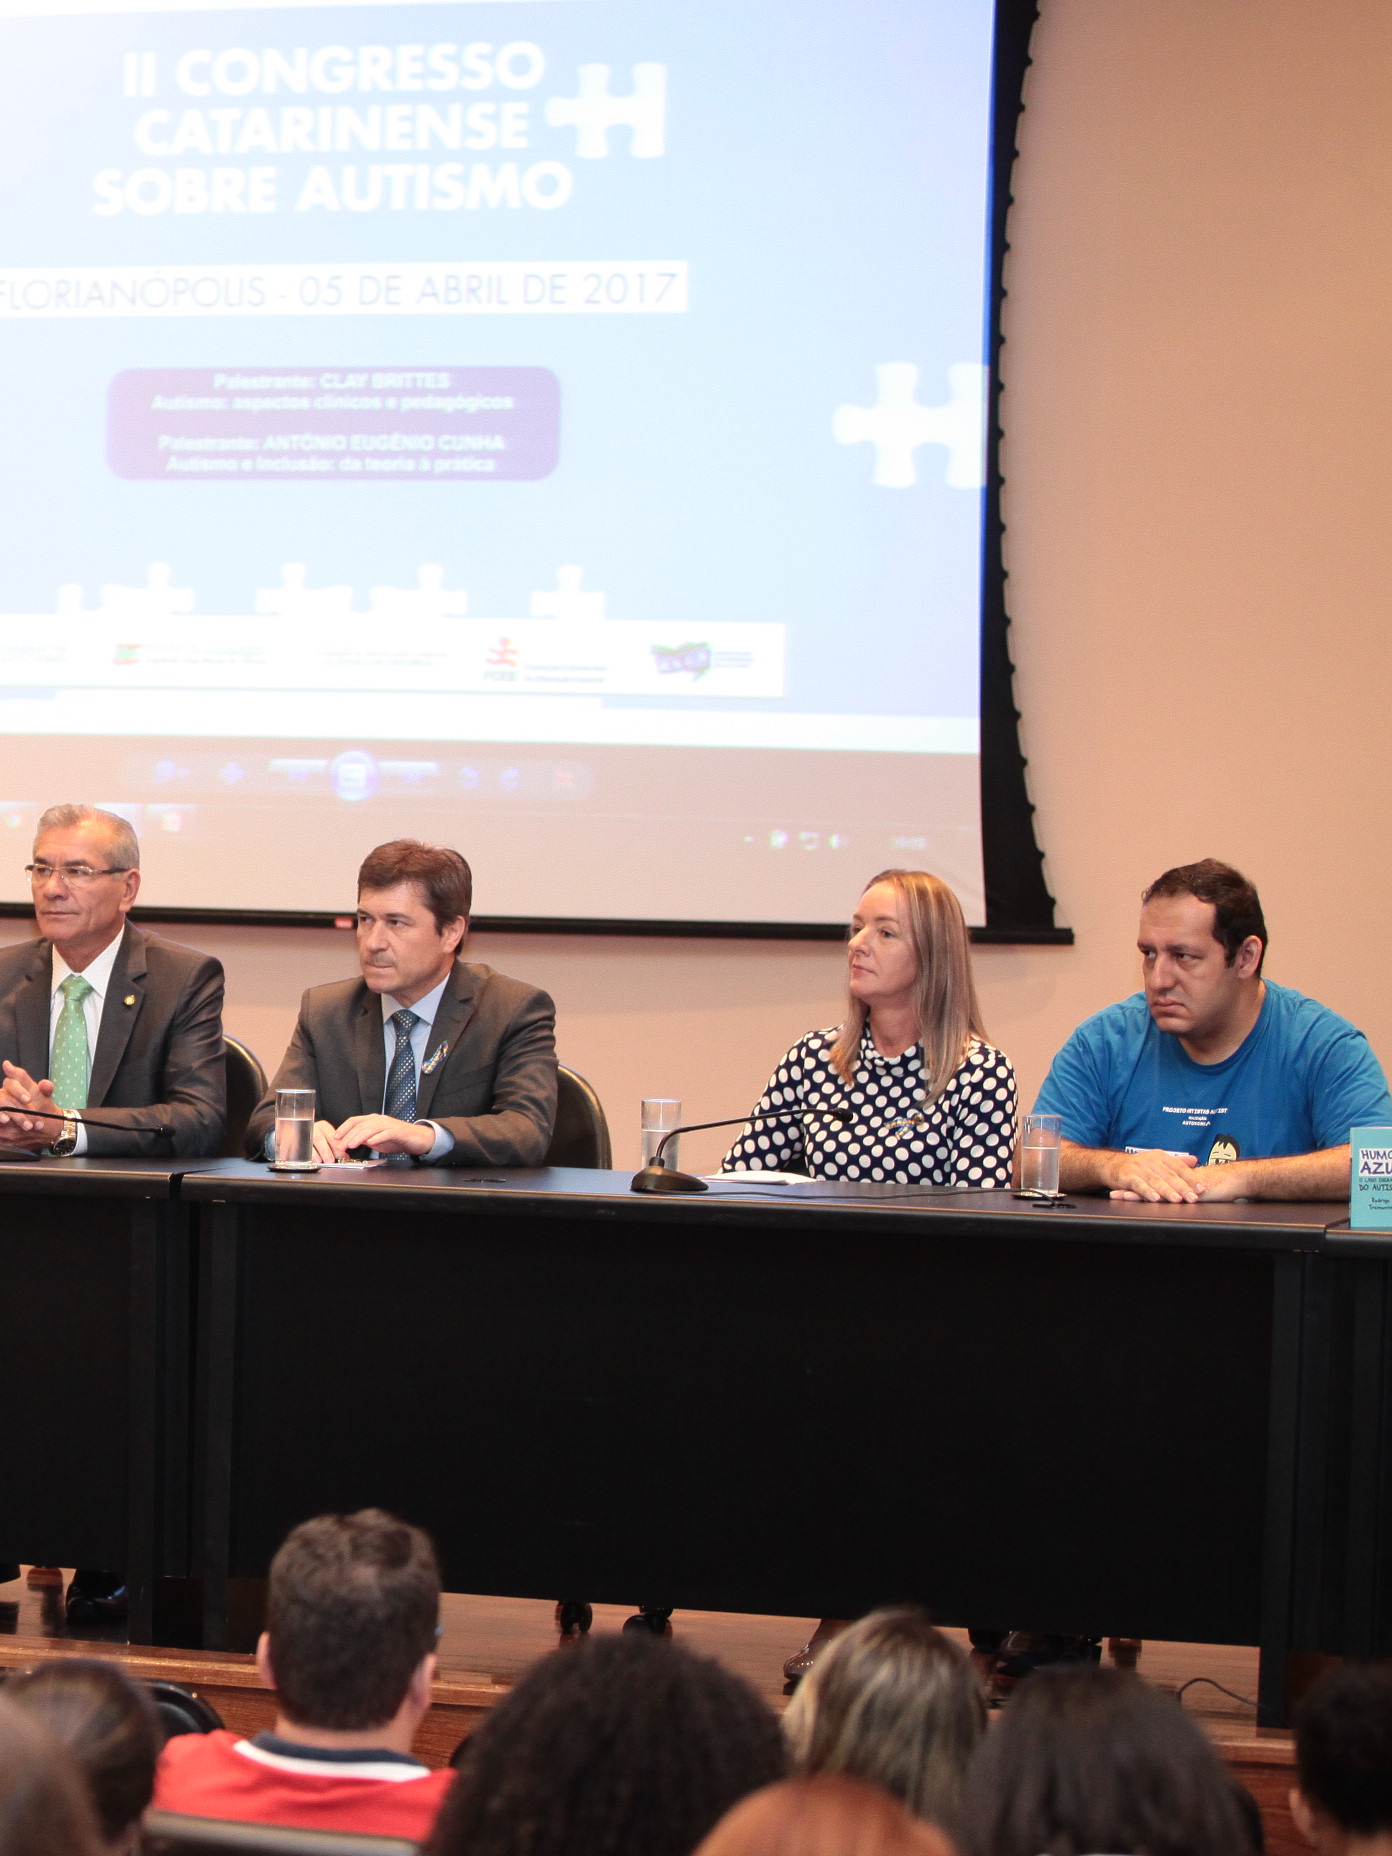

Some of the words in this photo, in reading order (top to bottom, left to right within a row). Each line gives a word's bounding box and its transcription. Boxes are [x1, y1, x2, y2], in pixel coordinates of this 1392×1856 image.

[175, 41, 546, 97] CONGRESSO
[134, 102, 529, 157] CATARINENSE
[92, 165, 277, 217] SOBRE
[295, 161, 574, 213] AUTISMO
[299, 276, 343, 307] 05
[359, 275, 402, 306] DE
[417, 273, 508, 306] ABRIL
[523, 273, 566, 305] DE
[582, 272, 679, 305] 2017
[1360, 1149, 1392, 1160] HUMO
[1360, 1161, 1392, 1175] AZU
